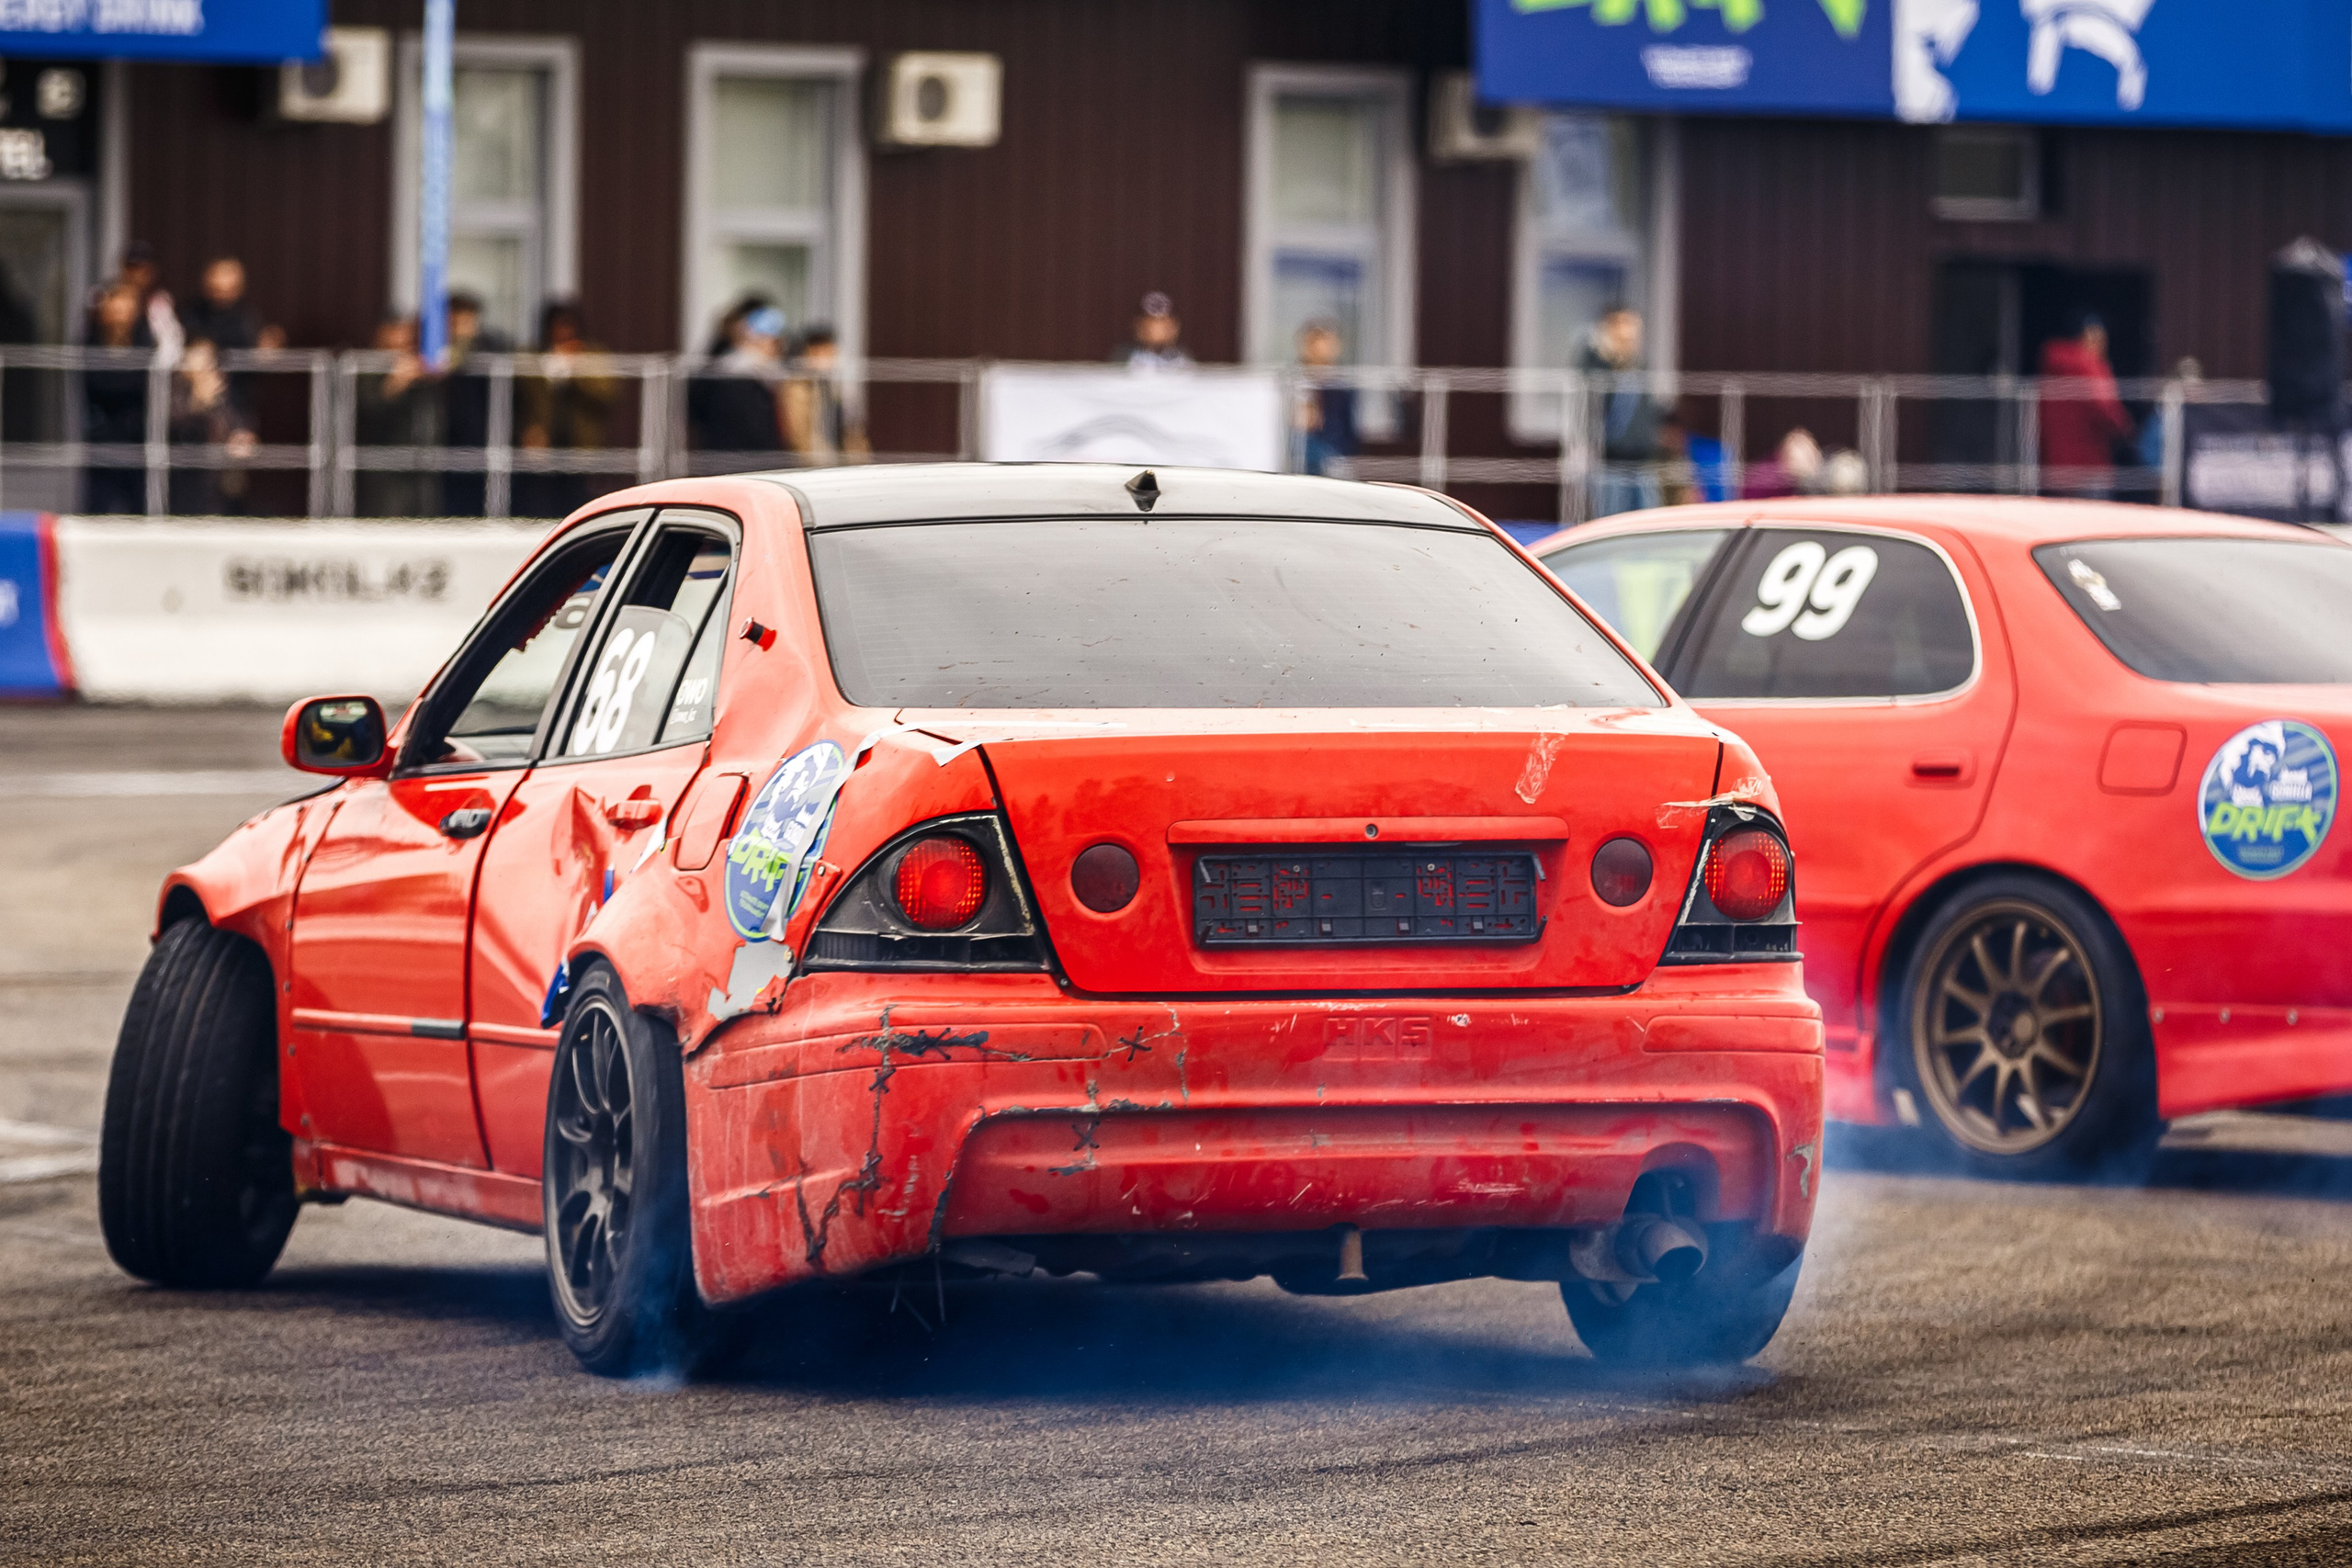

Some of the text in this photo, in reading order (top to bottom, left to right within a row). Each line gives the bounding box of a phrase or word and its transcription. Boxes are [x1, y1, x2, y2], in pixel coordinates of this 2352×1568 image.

[1741, 541, 1879, 640] 99
[573, 627, 656, 756] 68
[729, 827, 805, 894] DRIF
[1323, 1016, 1432, 1047] HKS
